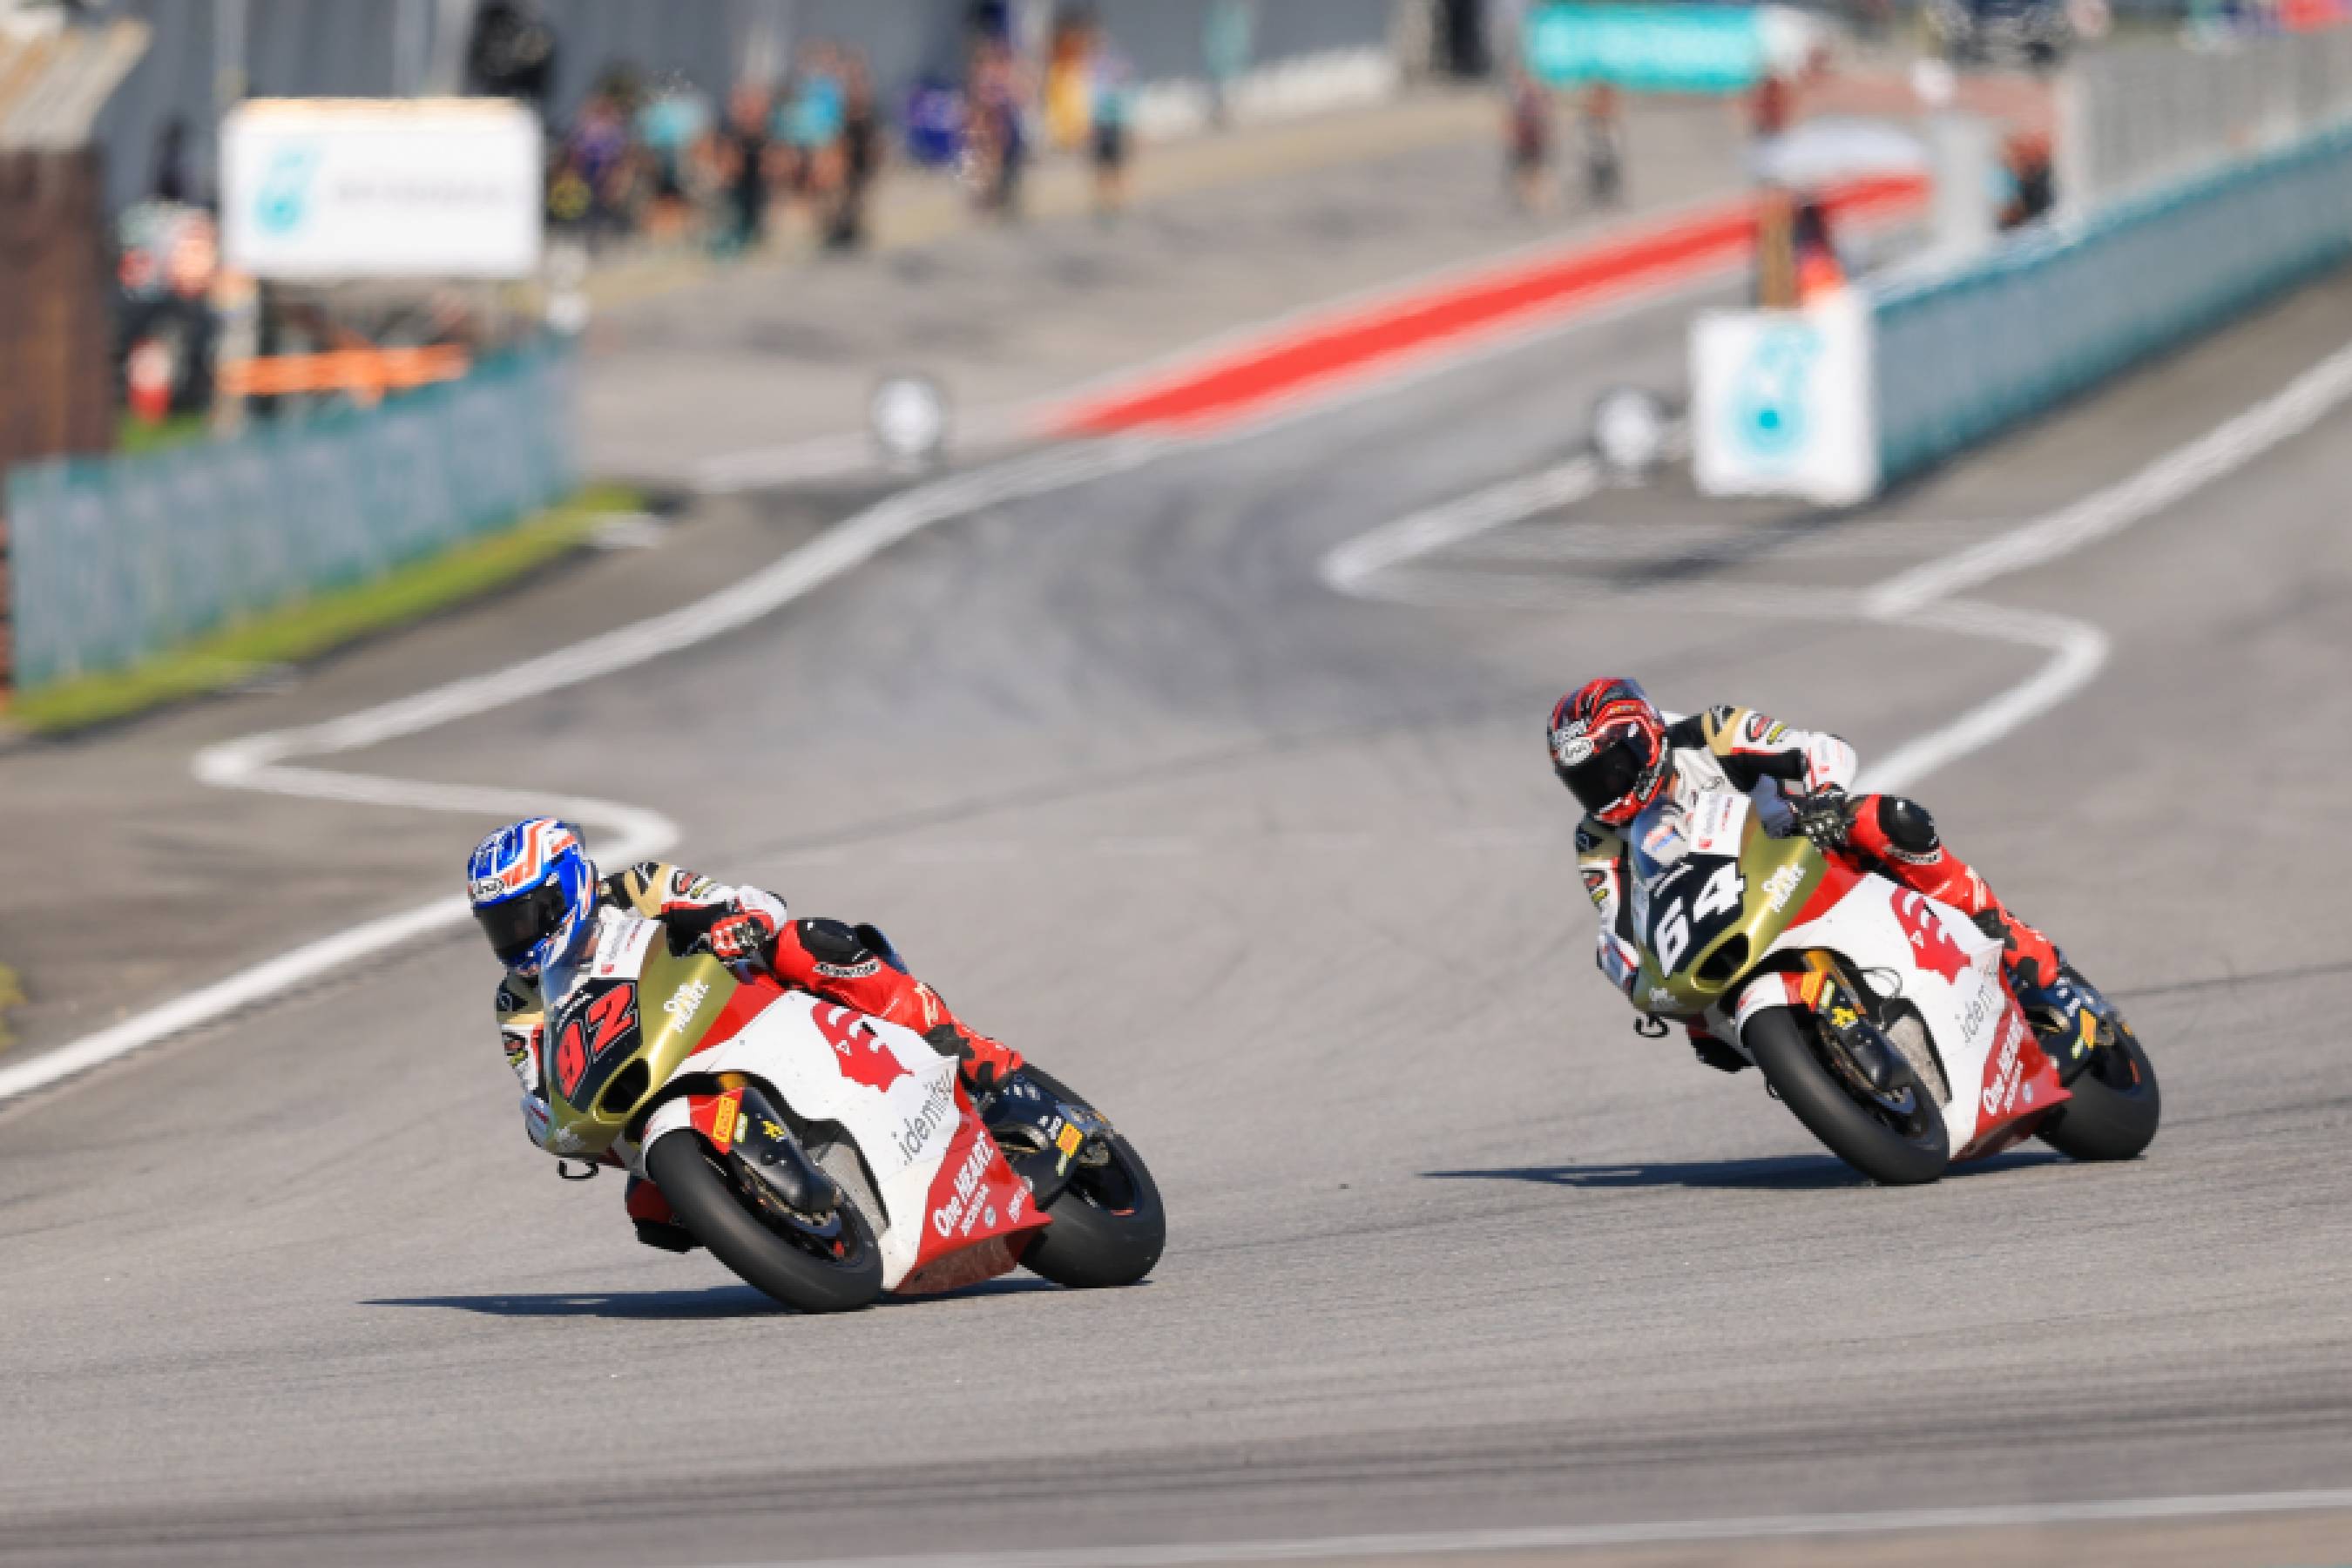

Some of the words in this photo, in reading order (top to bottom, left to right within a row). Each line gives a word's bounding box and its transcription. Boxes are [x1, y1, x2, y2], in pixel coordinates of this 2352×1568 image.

[1656, 861, 1745, 979] 64
[557, 983, 637, 1100] 92
[932, 1195, 963, 1239] One
